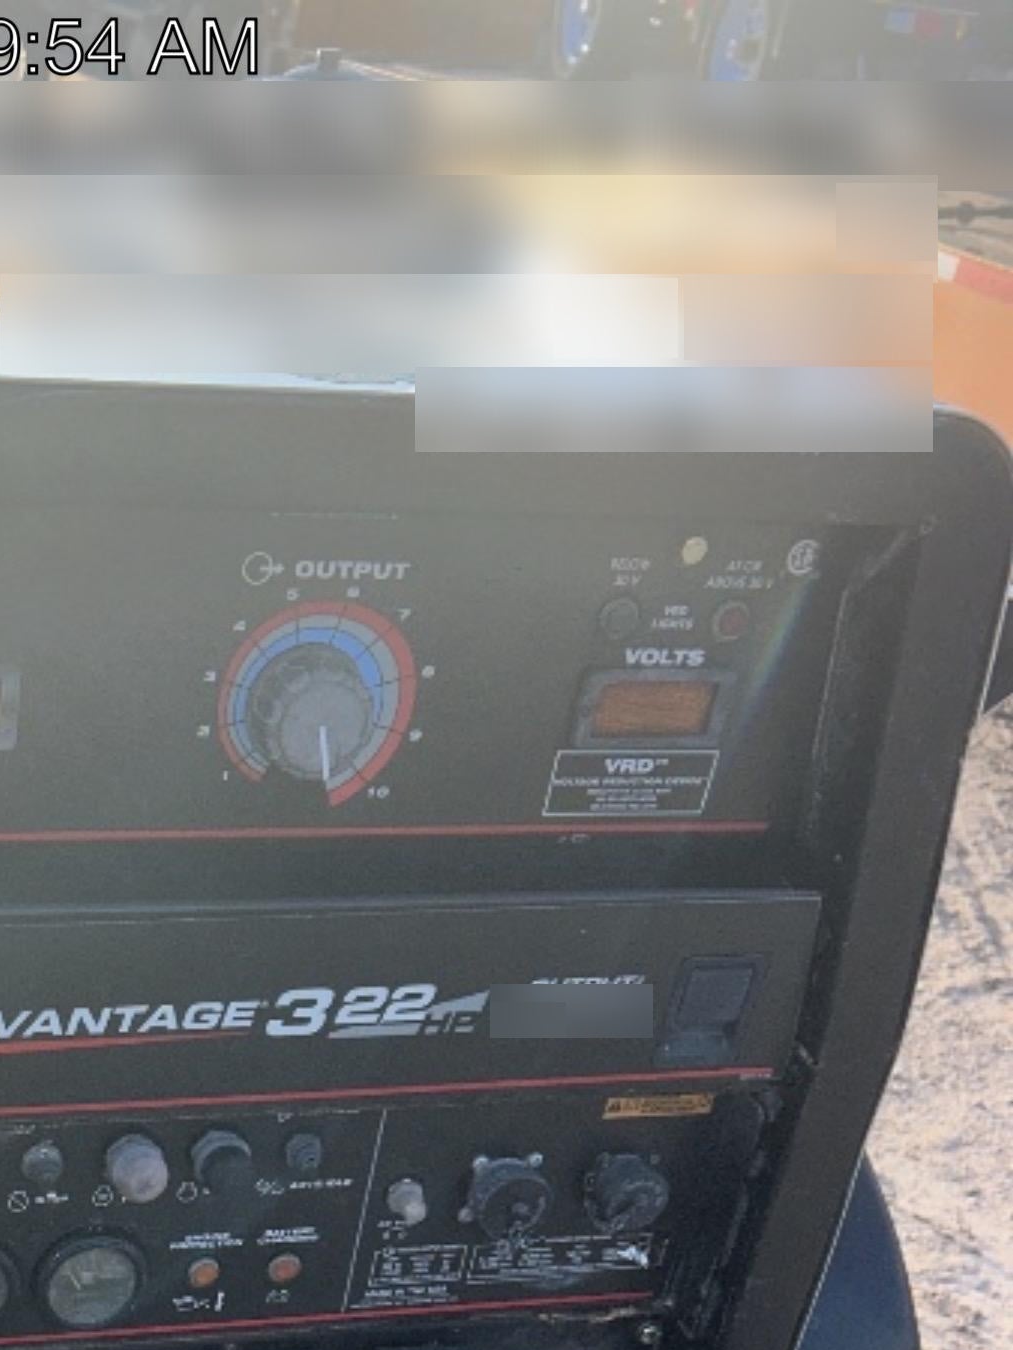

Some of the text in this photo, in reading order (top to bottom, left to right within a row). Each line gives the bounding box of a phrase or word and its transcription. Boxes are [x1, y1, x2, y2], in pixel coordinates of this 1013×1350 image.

[295, 560, 411, 580] OUTPUT
[287, 588, 300, 600] 5
[397, 608, 411, 622] 7
[625, 648, 706, 667] VOLTS
[368, 785, 389, 799] 10
[266, 983, 438, 1037] 322
